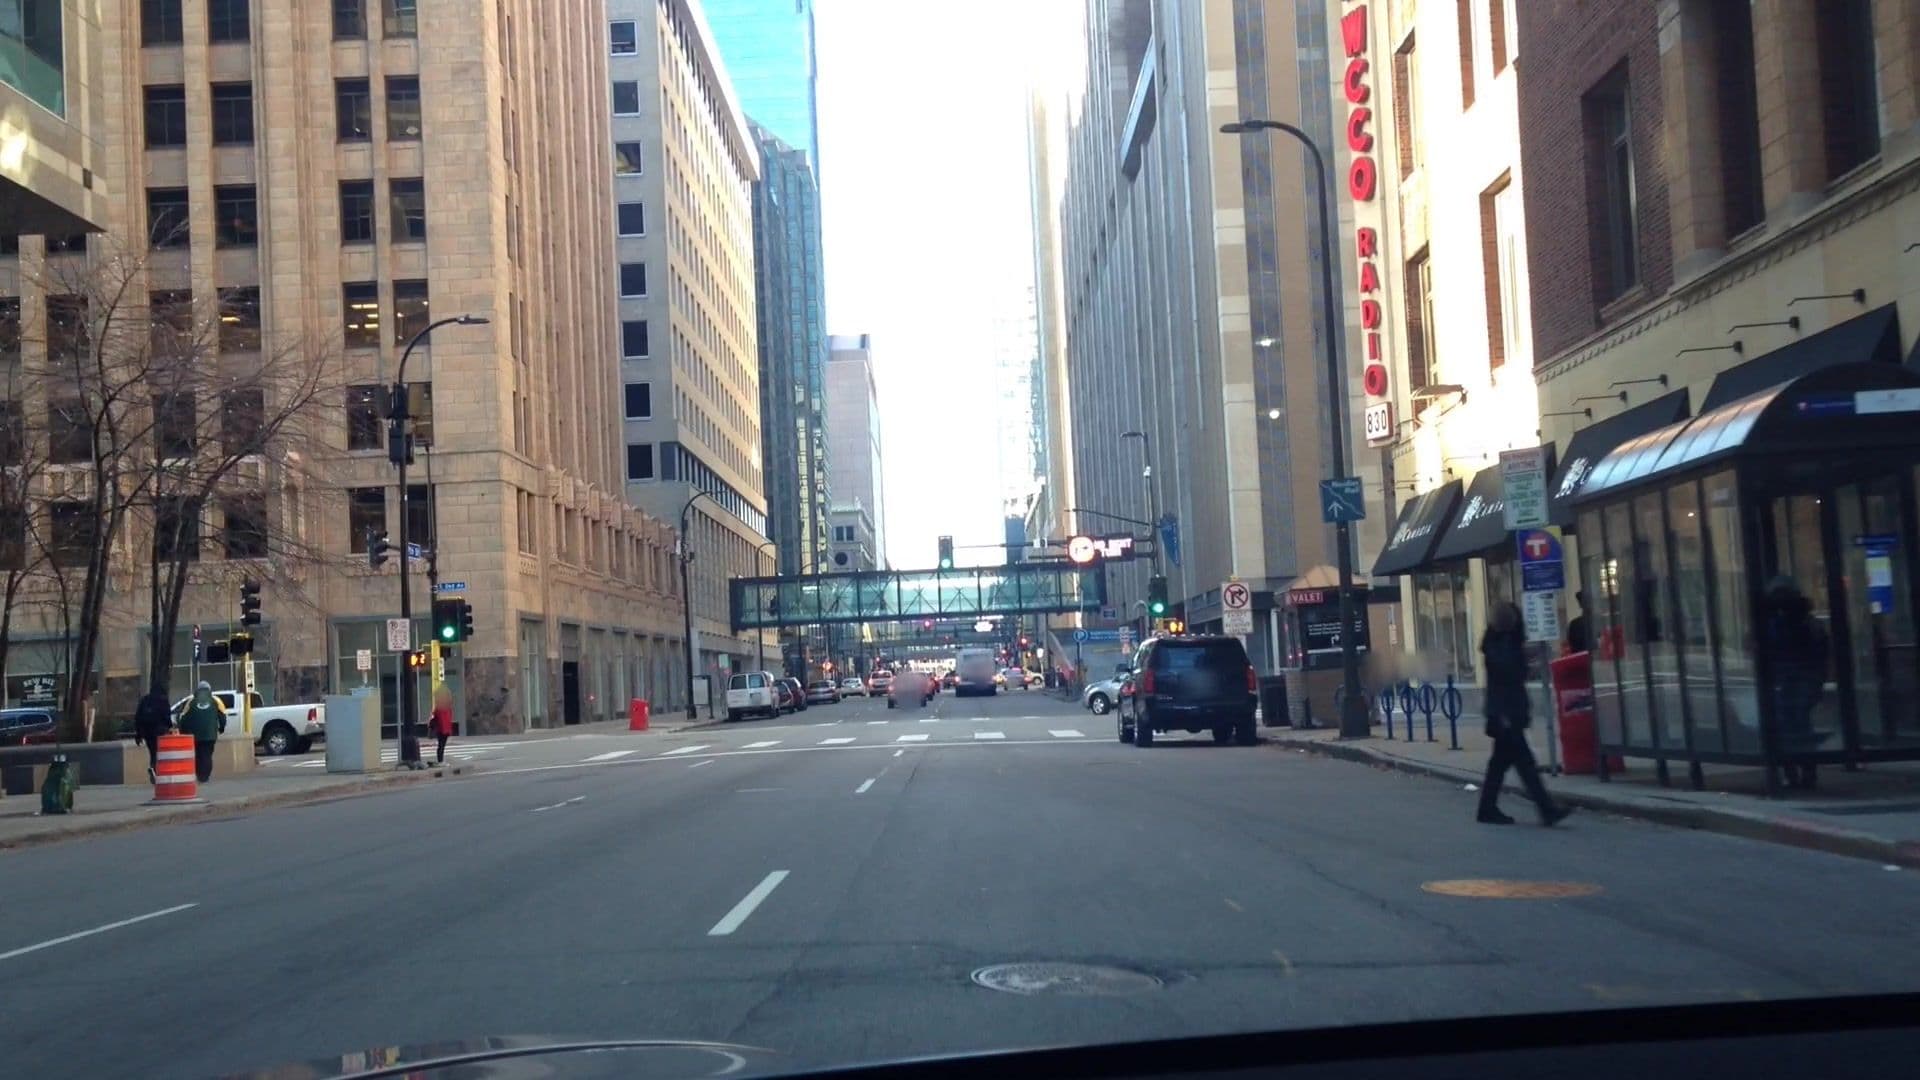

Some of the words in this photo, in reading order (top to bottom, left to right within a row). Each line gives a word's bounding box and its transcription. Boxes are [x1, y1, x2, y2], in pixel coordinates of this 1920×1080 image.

[1340, 4, 1378, 203] WCCO
[1357, 227, 1388, 397] RADIO
[1366, 410, 1388, 434] 830
[1291, 592, 1321, 603] VALET
